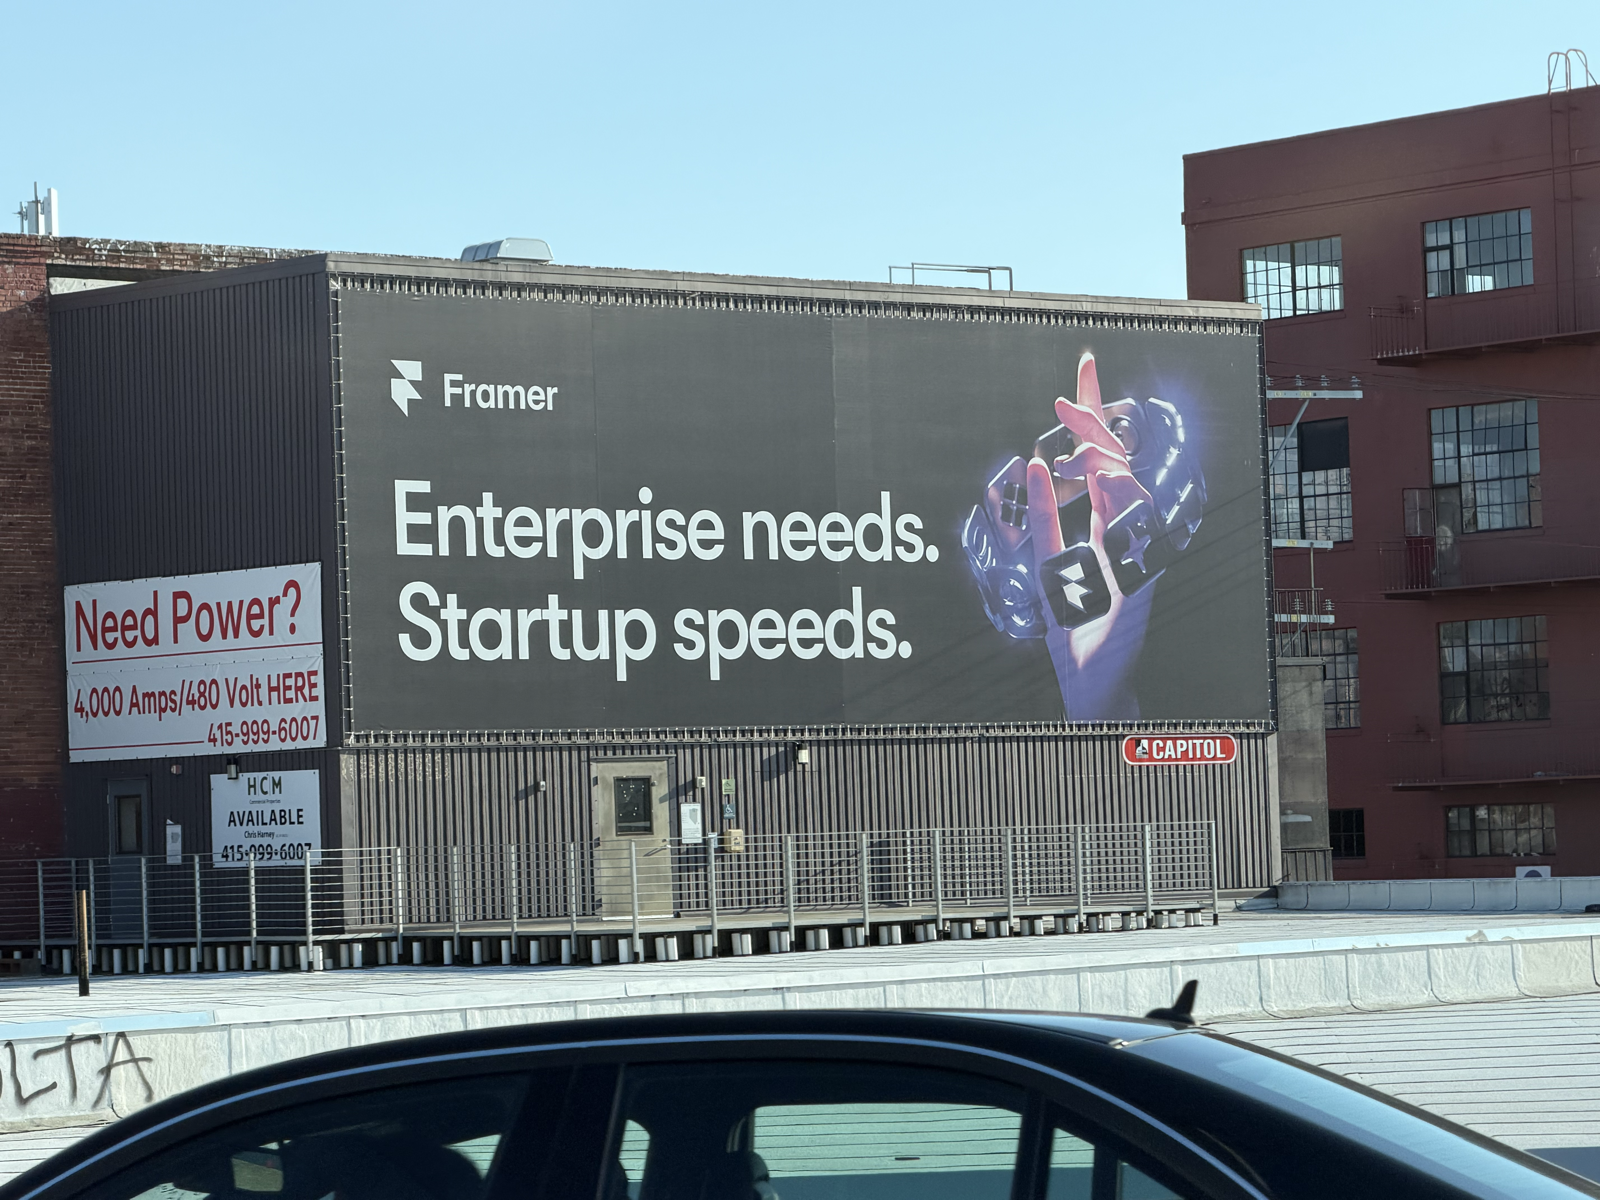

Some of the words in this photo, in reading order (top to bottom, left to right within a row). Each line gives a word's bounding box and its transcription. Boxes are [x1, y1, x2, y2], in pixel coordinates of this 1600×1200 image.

[443, 373, 558, 411] Framer
[394, 479, 725, 580] Enterprise
[742, 490, 939, 563] needs.
[75, 590, 159, 652] Need
[172, 579, 302, 644] Power?
[398, 581, 657, 682] Startup
[673, 586, 912, 681] speeds.
[74, 685, 123, 723] 4,000
[128, 678, 220, 721] Amps/480
[225, 673, 263, 708] Volt
[267, 670, 319, 705] HERE
[207, 715, 320, 747] 415-999-6007
[1152, 739, 1226, 759] CAPITOL
[228, 808, 304, 827] AVAILABLE
[244, 831, 257, 839] Chris
[257, 831, 275, 840] Harney
[0, 1032, 154, 1109] LTA
